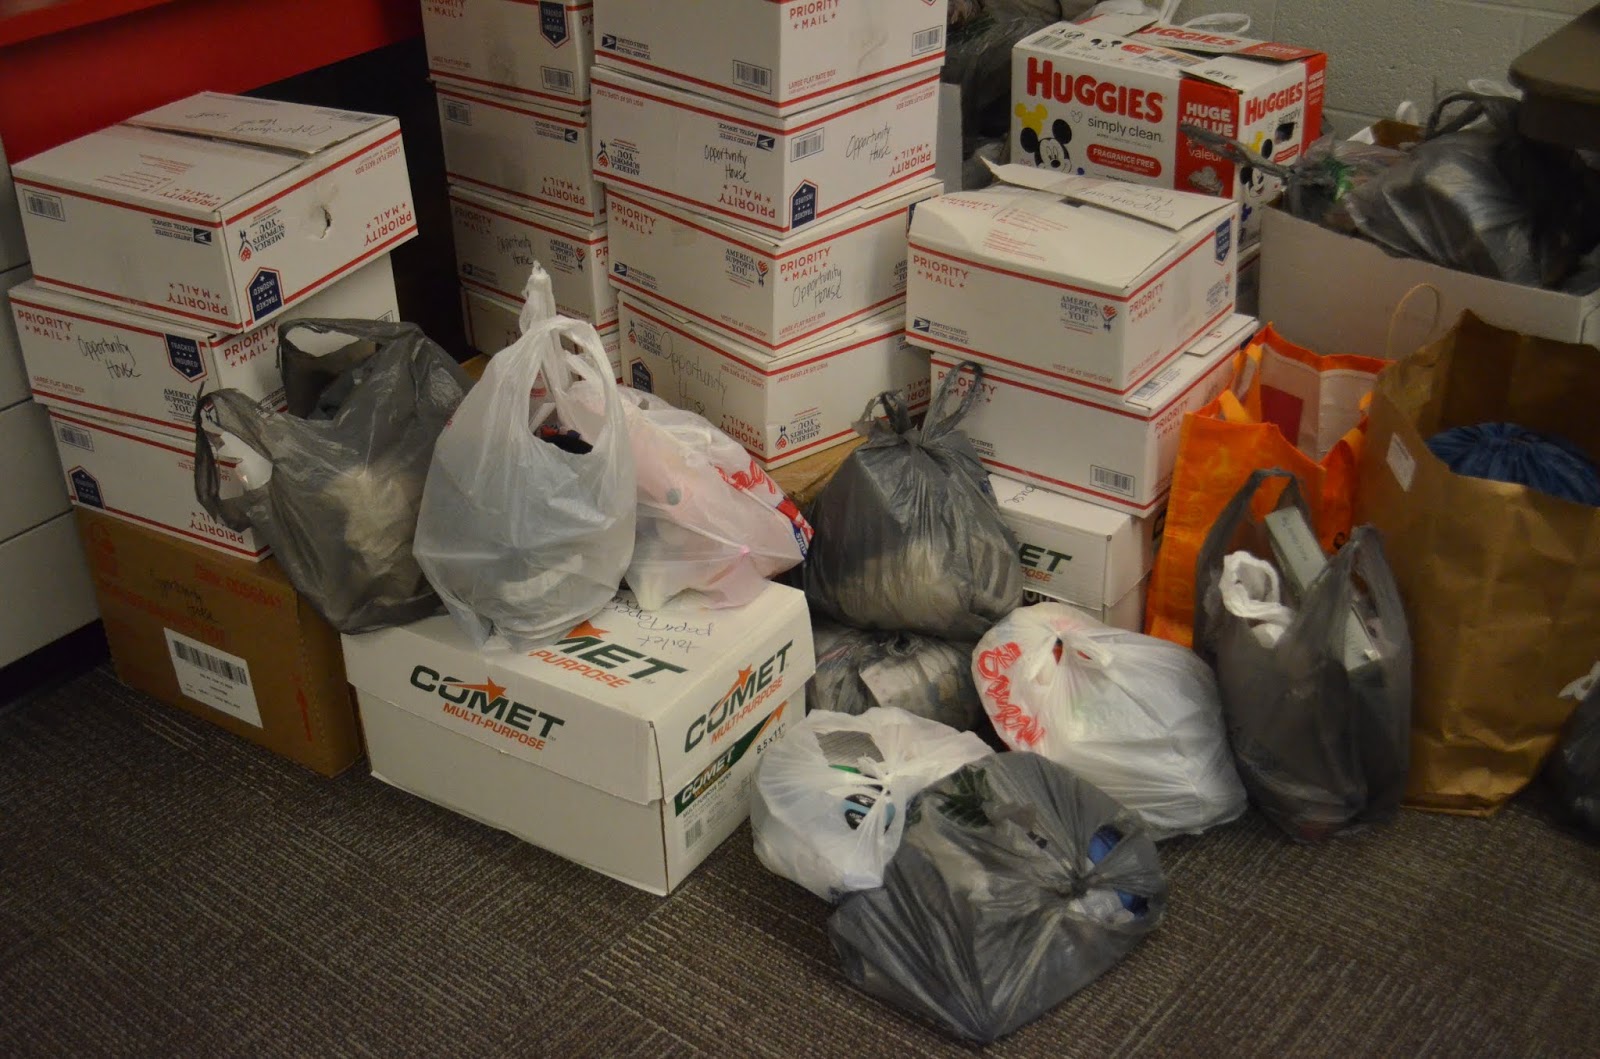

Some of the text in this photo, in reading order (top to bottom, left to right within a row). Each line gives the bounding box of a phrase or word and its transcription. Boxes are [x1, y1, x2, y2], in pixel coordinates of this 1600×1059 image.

[433, 6, 457, 18] MAIL
[790, 0, 839, 19] PRIORITY
[802, 14, 828, 29] MAIL
[1141, 27, 1242, 46] UGGIES
[788, 79, 803, 89] LARGE
[826, 69, 836, 78] BOX
[1027, 57, 1163, 123] HUGGIES
[1186, 102, 1231, 122] HUGE
[1244, 82, 1303, 126] HUGGIES
[1088, 116, 1126, 135] simply
[1129, 126, 1161, 142] clean
[1182, 116, 1233, 137] VALUE
[846, 122, 891, 160] Opportunity
[618, 150, 633, 161] YOU
[705, 145, 748, 167] Opportunity
[901, 146, 923, 159] MAIL
[1093, 148, 1135, 164] FRAGRANCE
[1136, 158, 1155, 169] FREE
[610, 155, 640, 169] SUPPORTS
[611, 162, 640, 176] AMERICA
[889, 151, 931, 177] PRIORITY
[725, 164, 749, 183] House
[550, 177, 573, 190] MAIL
[733, 185, 762, 199] MAIL
[159, 190, 218, 208] PRIORITY
[187, 189, 212, 200] MAIL
[541, 187, 585, 205] PRIORITY
[373, 206, 400, 224] MAIL
[611, 201, 655, 224] PRIORITY
[719, 193, 776, 219] PRIORITY
[260, 219, 277, 232] YOU
[454, 208, 492, 225] PRIORITY
[621, 217, 645, 234] MAIL
[252, 223, 285, 244] SUPPORTS
[364, 211, 412, 246] PRIORITY
[254, 231, 285, 252] AMERICA
[726, 248, 754, 264] AMERICA
[726, 256, 755, 271] SUPPORTS
[780, 246, 831, 273] PRIORITY
[732, 265, 747, 277] YOU
[792, 266, 818, 281] MAIL
[913, 255, 969, 279] PRIORITY
[253, 280, 275, 291] INSURED
[792, 263, 842, 307] Opportunity
[926, 273, 955, 288] MAIL
[181, 283, 211, 299] MAIL
[815, 283, 842, 308] House
[1128, 282, 1164, 313] PRIORITY
[168, 293, 228, 316] PRIORITY
[256, 295, 278, 311] TRACKED
[1061, 296, 1098, 310] AMERICA
[1061, 303, 1099, 317] SUPPORTS
[18, 310, 72, 331] PRIORITY
[1068, 312, 1088, 323] YOU
[1137, 305, 1156, 321] MAIL
[33, 326, 62, 340] MAIL
[224, 321, 277, 359] PRIORITY
[78, 335, 136, 367] Opportunity
[171, 342, 196, 353] TRACKED
[240, 344, 268, 364] MAIL
[105, 359, 141, 379] House
[164, 388, 197, 401] AMERICA
[164, 395, 197, 406] SUPPORT
[173, 403, 192, 414] YOU
[732, 415, 754, 433] MAIL
[790, 423, 821, 438] SUPPORTS
[798, 418, 816, 429] YOU
[721, 421, 763, 451] PRIORITY
[790, 430, 820, 445] AMERICA
[191, 519, 244, 543] PRIORITY
[554, 636, 688, 679] MET
[410, 664, 565, 738] COMET
[684, 639, 793, 753] COMET
[711, 675, 784, 745] MULTI-PURPOSE
[443, 702, 546, 751] MULTI-PURPOSE
[757, 741, 768, 755] 8.5
[682, 746, 736, 804] COMET
